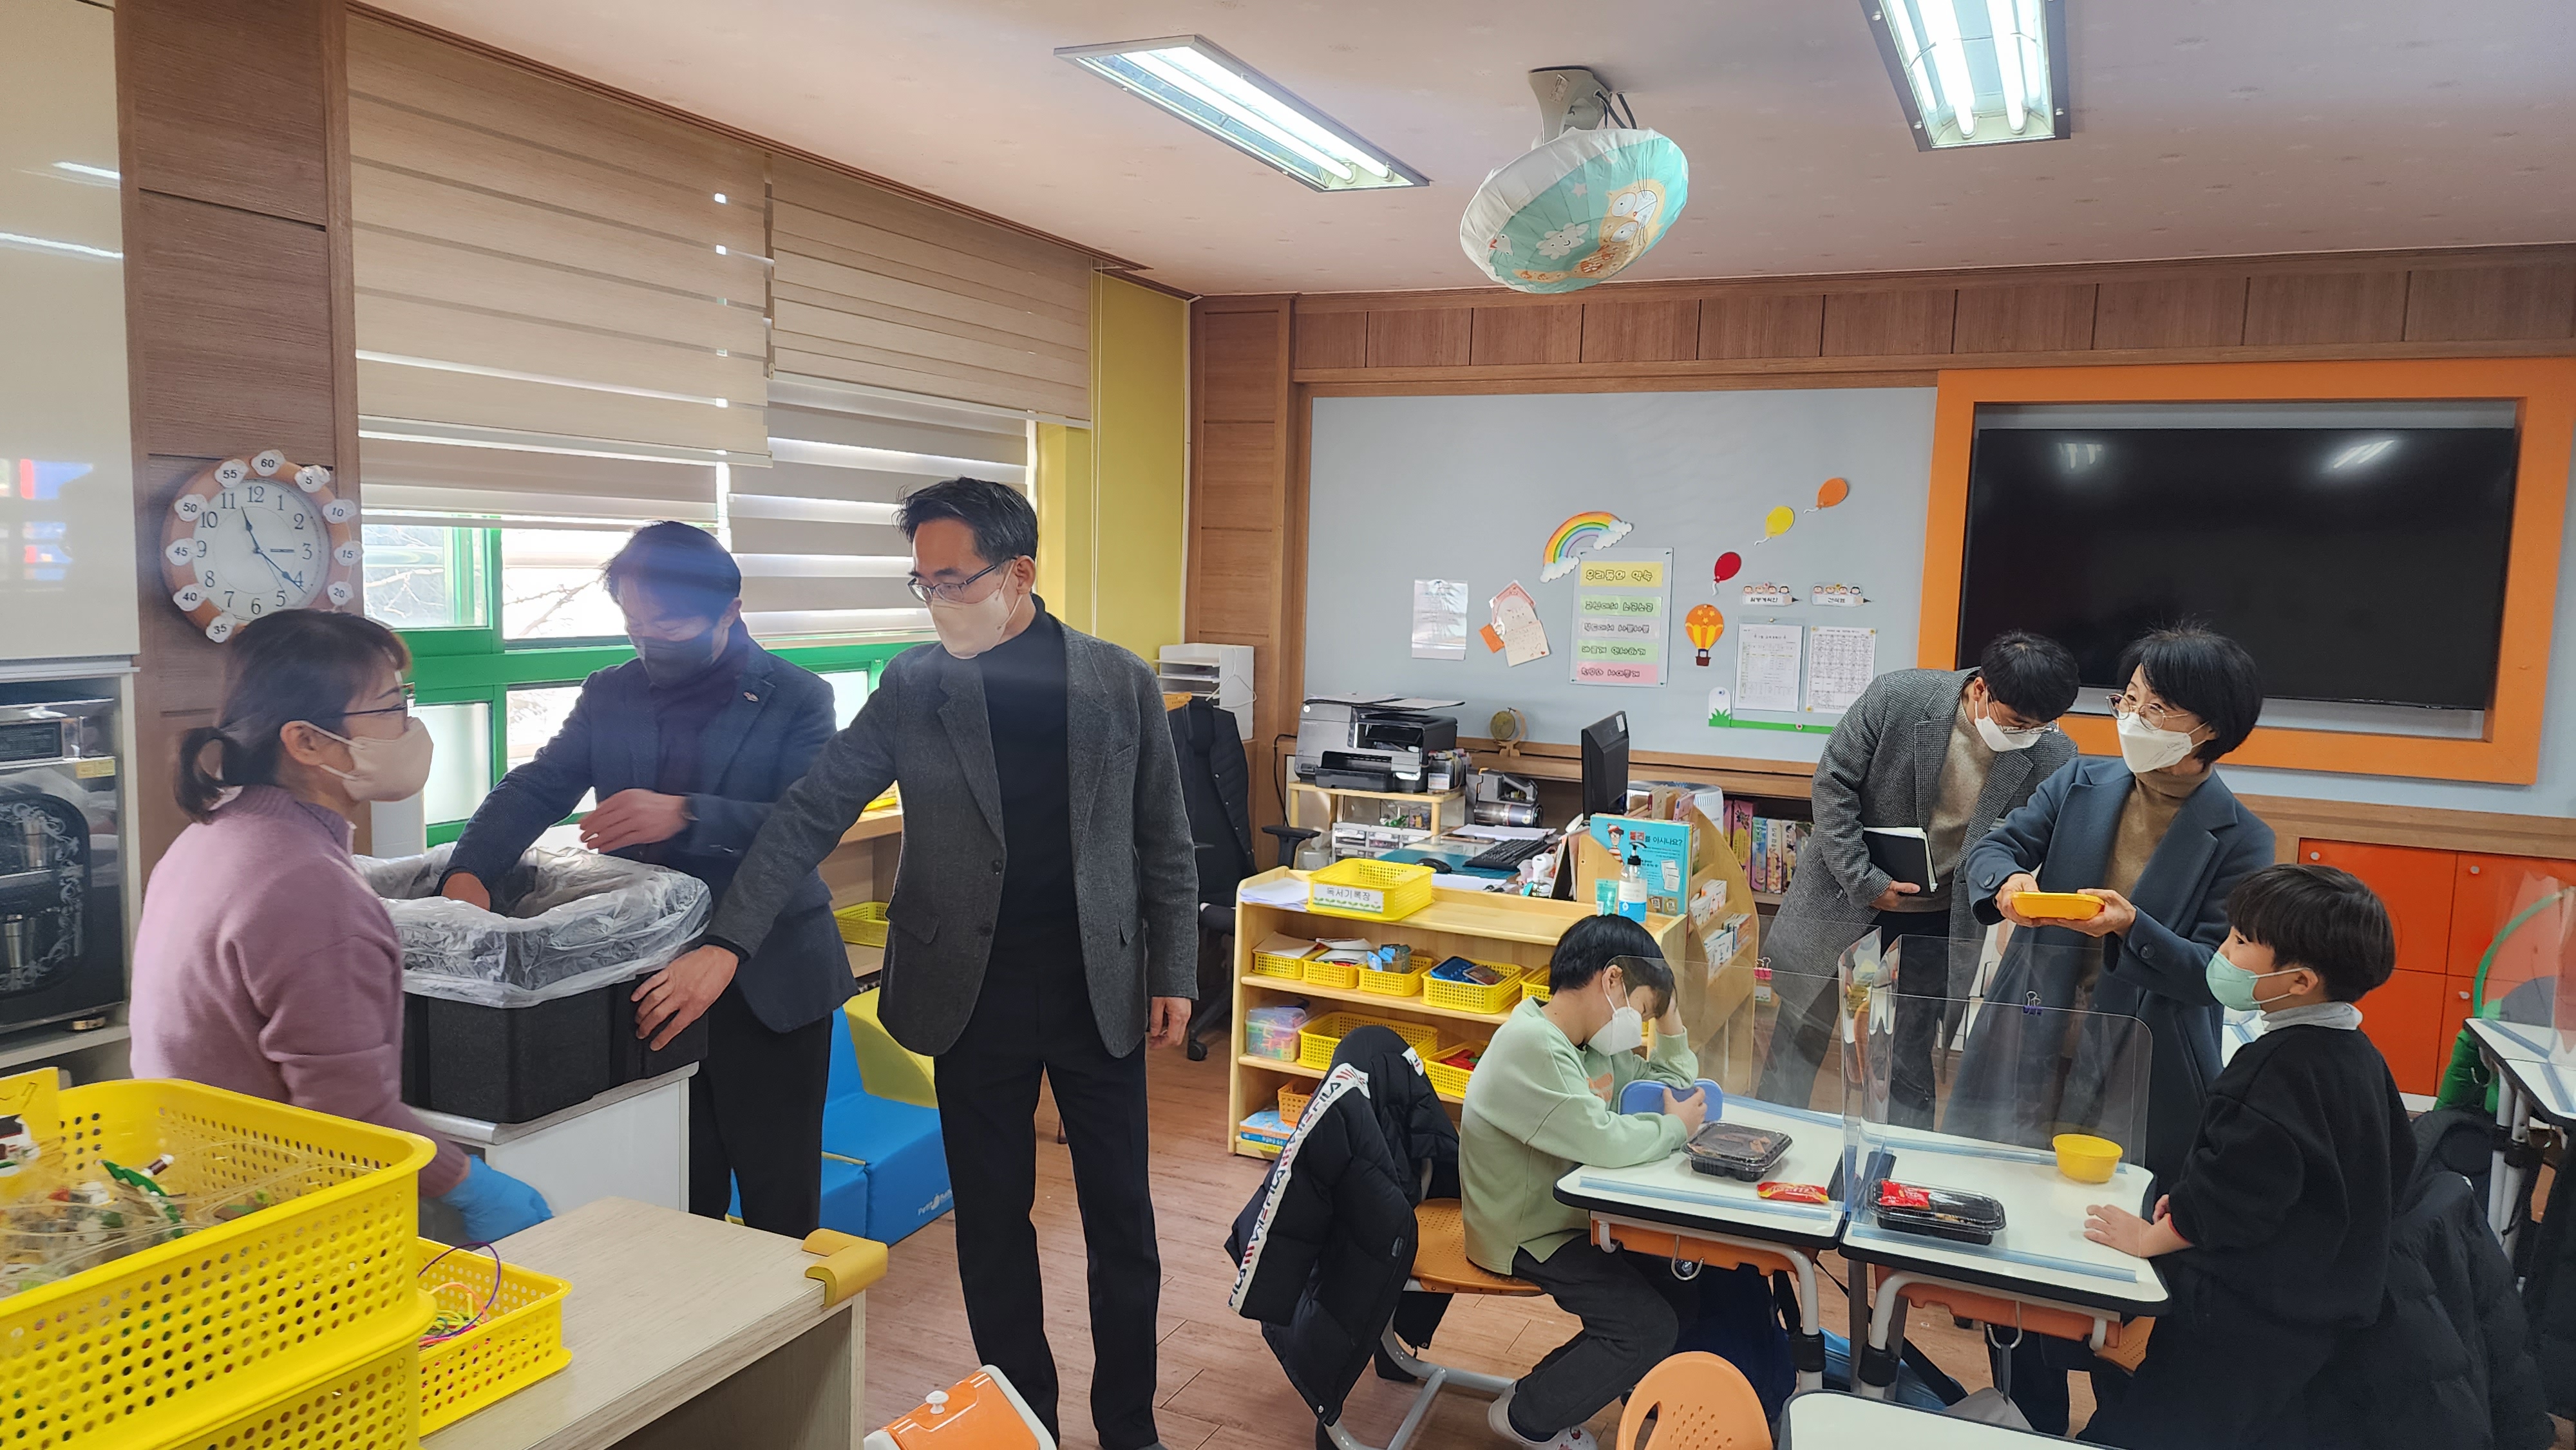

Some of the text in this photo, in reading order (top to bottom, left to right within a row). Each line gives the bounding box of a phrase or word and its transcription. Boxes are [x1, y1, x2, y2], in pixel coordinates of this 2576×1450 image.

[261, 458, 274, 467] 60
[223, 469, 237, 478] 55
[305, 476, 313, 484] 5
[221, 492, 236, 509] 11
[247, 486, 264, 503] 12
[183, 502, 197, 513] 50
[277, 494, 284, 511] 1
[332, 507, 344, 517] 10
[200, 511, 218, 528] 10
[294, 513, 304, 530] 2
[174, 547, 188, 556] 45
[196, 540, 207, 558] 9
[302, 543, 312, 560] 3
[342, 550, 354, 558] 15
[205, 570, 214, 587] 8
[294, 570, 303, 587] 4
[1586, 569, 1653, 581] 우리들의 약속
[182, 592, 197, 601] 40
[224, 590, 234, 608] 7
[276, 590, 285, 607] 5
[333, 588, 345, 598] 20
[251, 598, 261, 615] 6
[1623, 602, 1653, 612] 소곤소곤
[213, 623, 227, 634] 35
[1611, 646, 1645, 655] 인사하기
[1653, 836, 1683, 847] 아시나요?
[1327, 887, 1370, 901] 독서기록장
[1312, 1082, 1341, 1112] FILA
[1265, 1169, 1286, 1207] FILA
